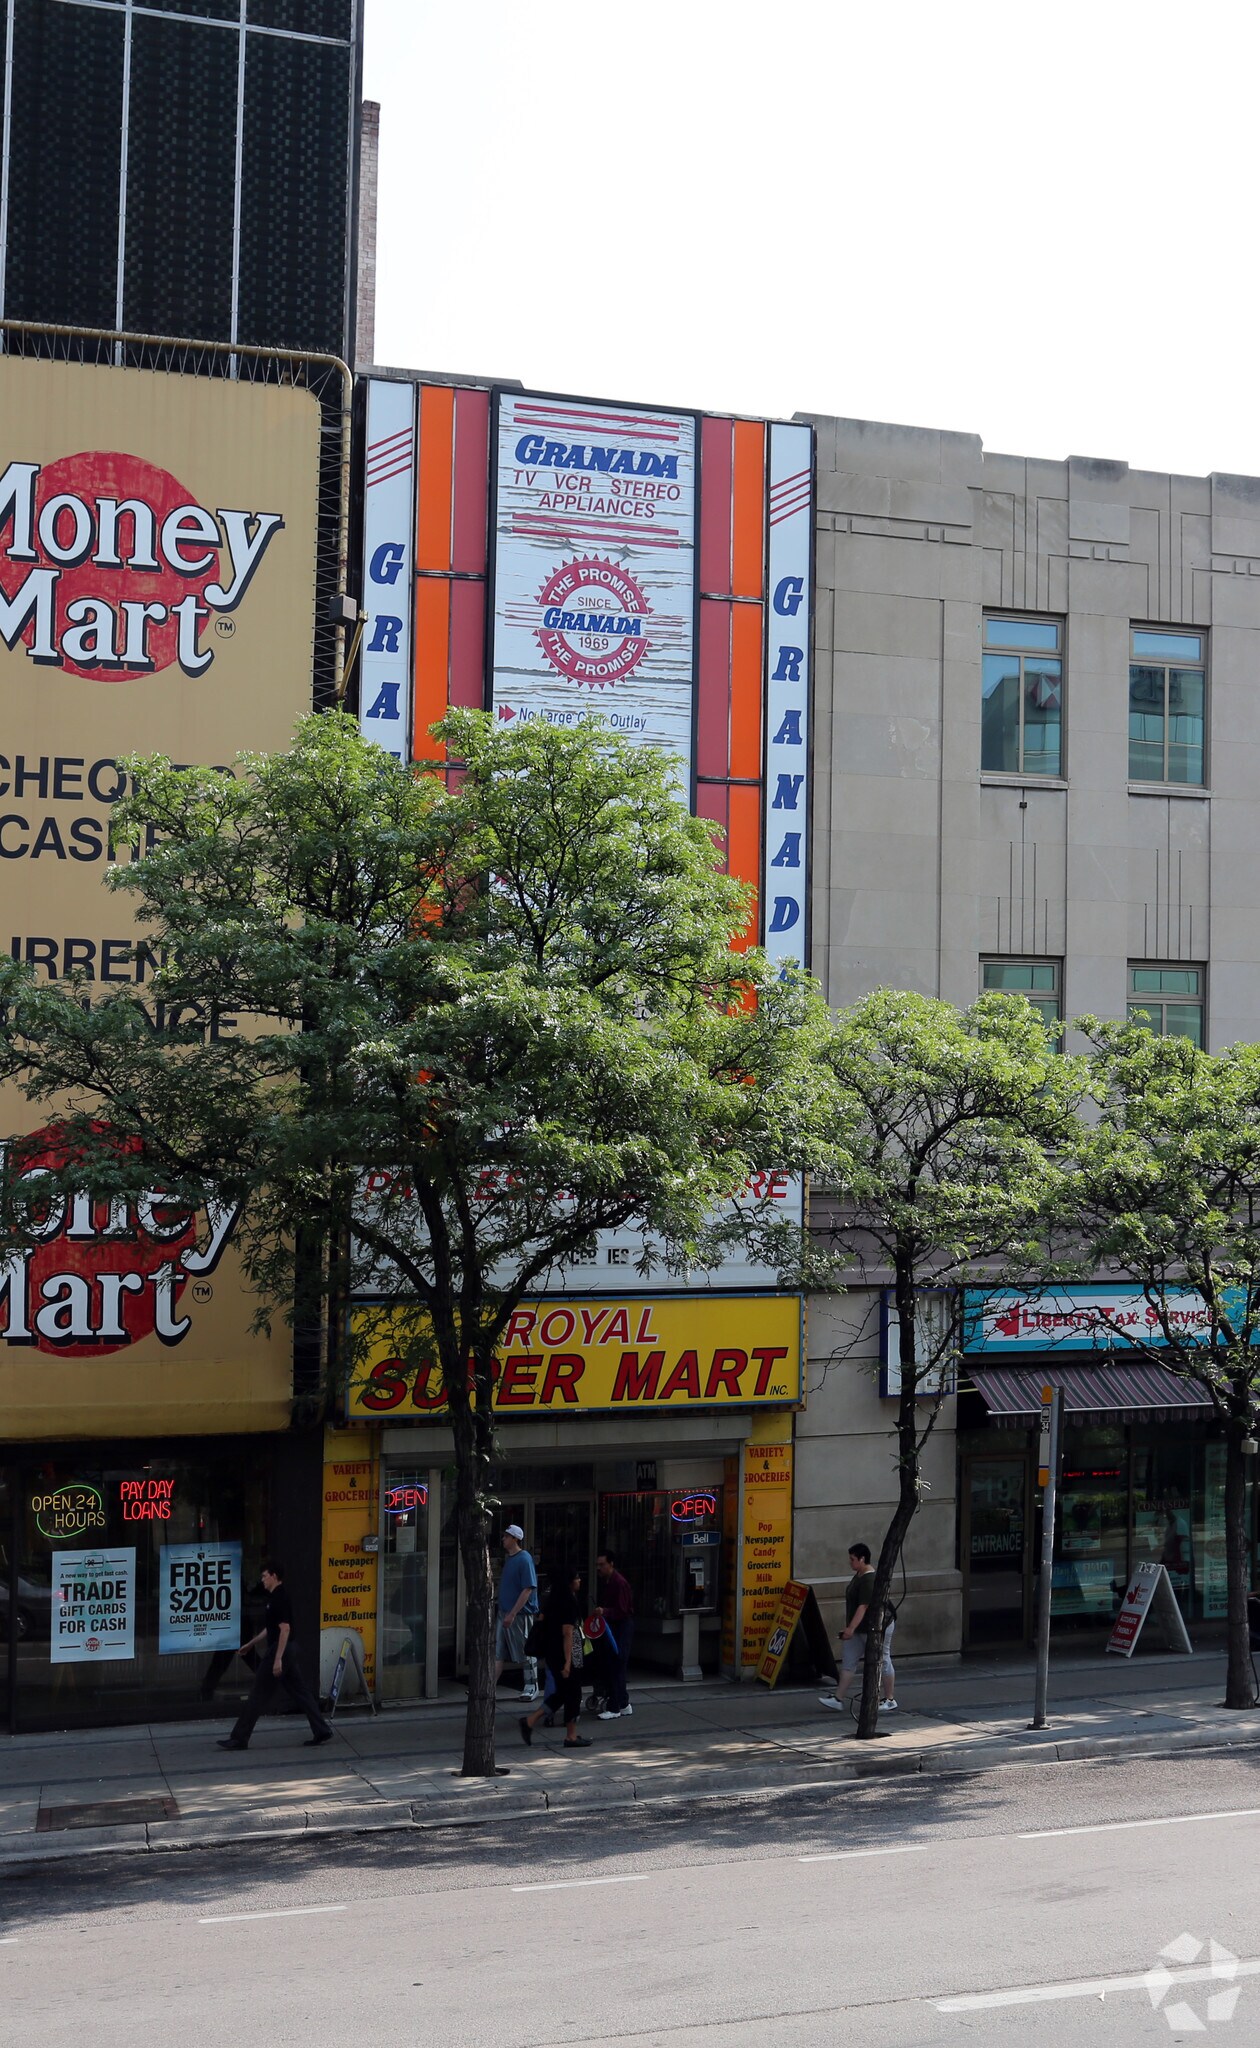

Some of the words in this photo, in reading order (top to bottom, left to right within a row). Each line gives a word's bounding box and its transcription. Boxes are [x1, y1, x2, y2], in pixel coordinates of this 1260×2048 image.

[514, 434, 679, 480] GRANADA
[512, 469, 537, 486] TV
[555, 472, 592, 491] VCR
[610, 478, 681, 501] STEREO
[538, 492, 656, 518] APPLIANCES
[0, 461, 286, 614] Money
[548, 573, 575, 602] THE
[578, 568, 640, 612] PROMISE
[577, 596, 611, 608] SINCE
[543, 607, 642, 636] GRANADA
[578, 636, 609, 650] 1969
[548, 632, 572, 665] THE
[574, 641, 639, 676] PROMISE
[611, 713, 648, 730] Outlay
[503, 1306, 660, 1349] ROYAL
[611, 1346, 789, 1402] MART
[769, 1384, 789, 1396] INC.
[750, 1447, 785, 1459] VARIETY
[637, 1463, 656, 1480] ATM
[763, 1460, 770, 1471] &
[120, 1480, 146, 1500] PAY
[148, 1479, 175, 1499] DAY
[349, 1477, 357, 1488] &
[31, 1495, 71, 1512] OPEN
[75, 1494, 96, 1510] 24
[123, 1501, 171, 1520] LOANS
[671, 1499, 717, 1517] OPEN
[55, 1510, 106, 1529] HOURS
[758, 1522, 773, 1533] Pop
[693, 1533, 709, 1544] Bell
[745, 1534, 785, 1546] Newspaper
[971, 1533, 1022, 1554] ENTRANCE
[344, 1543, 360, 1554] Pop
[753, 1547, 776, 1558] Candy
[328, 1557, 375, 1568] Newspaper
[747, 1560, 782, 1571] Groceries
[170, 1560, 232, 1588] FREE
[338, 1570, 364, 1581] Candy
[757, 1572, 773, 1583] Milk
[60, 1580, 127, 1602] TRADE
[332, 1584, 371, 1595] Groceries
[169, 1586, 232, 1613] $200
[342, 1597, 360, 1608] Milk
[753, 1598, 775, 1610] Juices
[60, 1604, 85, 1617] GIFT
[88, 1602, 127, 1615] CARDS
[59, 1621, 85, 1634] FOR
[91, 1617, 127, 1631] CASH
[169, 1614, 191, 1624] CASH
[193, 1612, 231, 1622] ADVANCE
[743, 1638, 758, 1649] Bus
